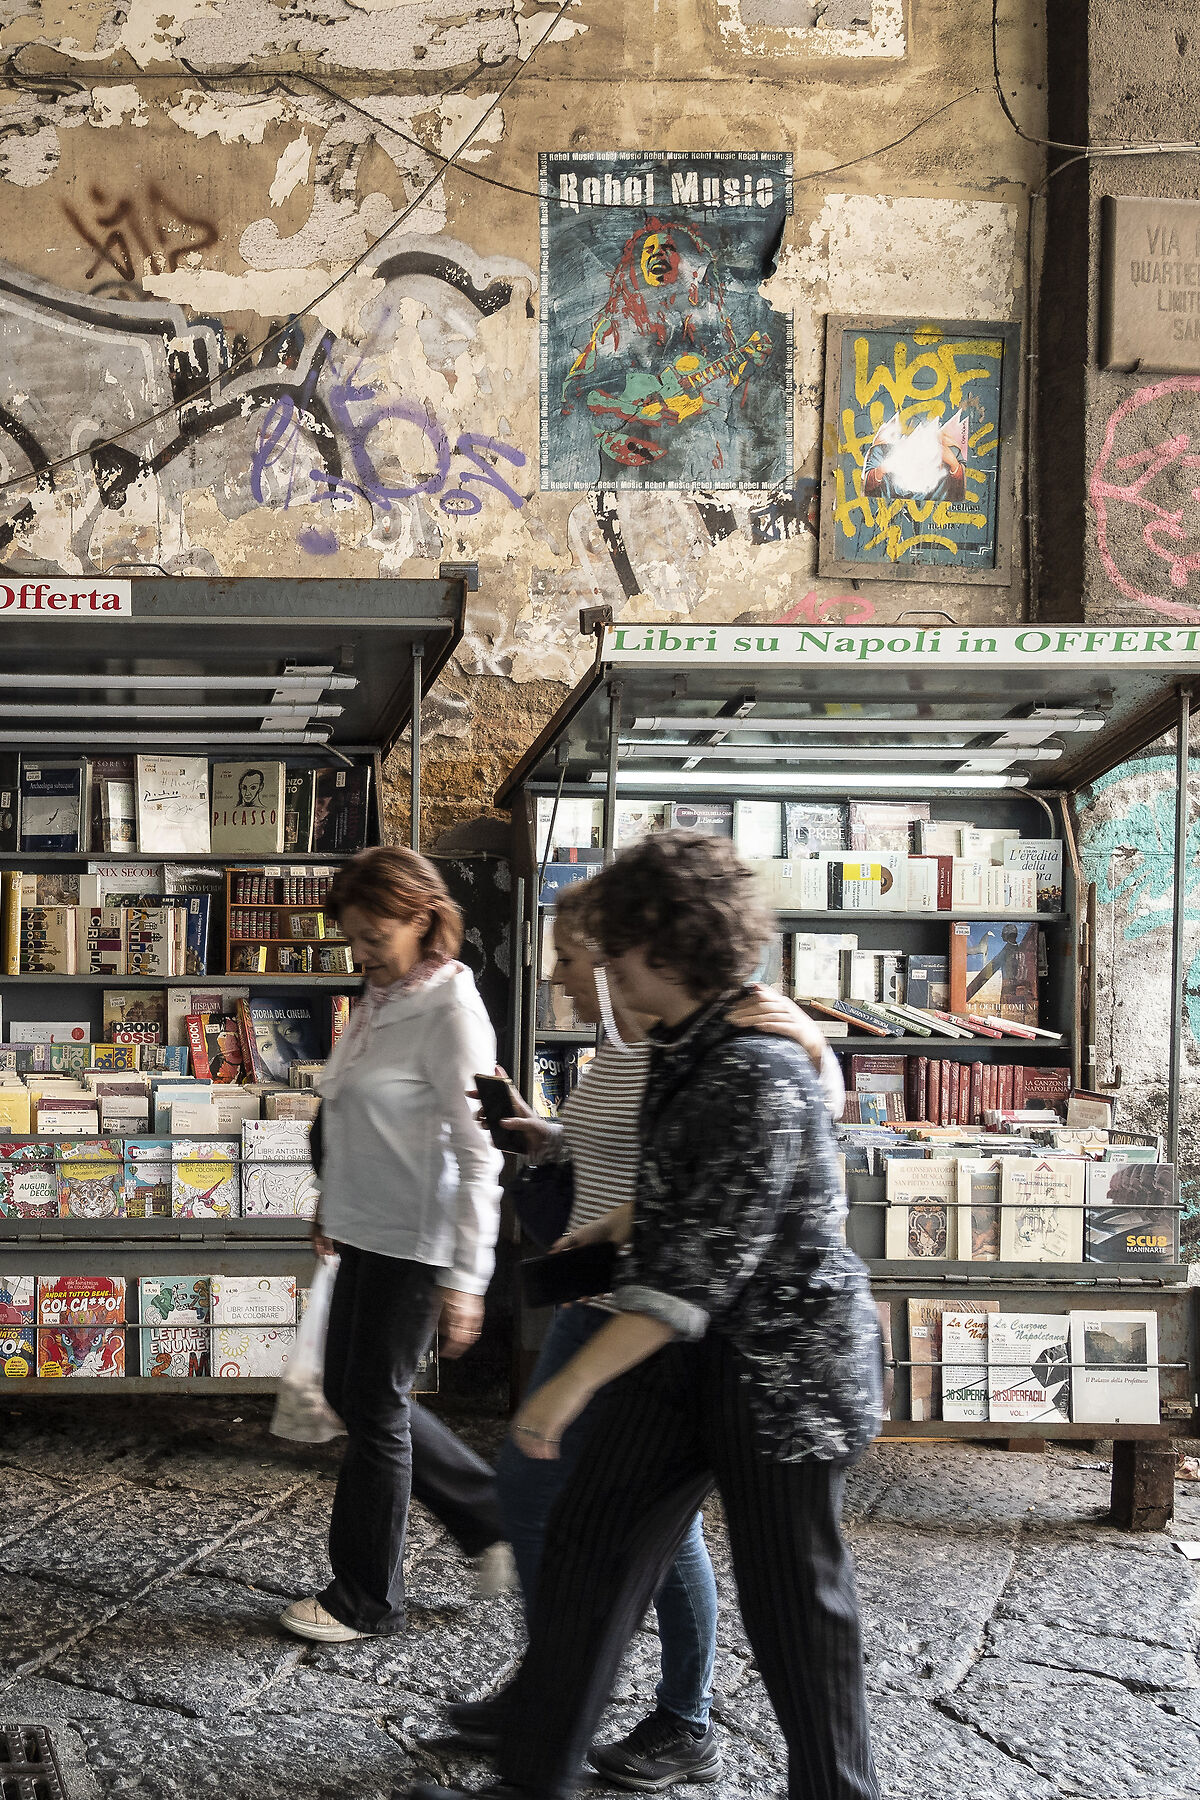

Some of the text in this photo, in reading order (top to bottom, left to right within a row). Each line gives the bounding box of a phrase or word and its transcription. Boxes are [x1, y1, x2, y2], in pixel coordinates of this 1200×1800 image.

[559, 171, 774, 213] Rebel Music
[1147, 225, 1180, 256] VIA
[611, 629, 718, 652] Libri
[734, 635, 780, 652] su
[800, 629, 943, 660] Napoli
[956, 629, 998, 653] in
[214, 810, 276, 826] PICASSO
[1010, 849, 1058, 862] L'eredità
[1022, 861, 1045, 871] della
[97, 868, 120, 877] XIX
[130, 909, 142, 975] ANTICA
[192, 1002, 220, 1010] HISPANIA
[252, 1009, 311, 1019] STORIA DEL CINEMA
[113, 1022, 159, 1033] paolo
[112, 1033, 160, 1044] rossi
[188, 1022, 202, 1052] IL ROCK
[41, 1299, 67, 1313] COL
[947, 1317, 961, 1327] La
[993, 1319, 1048, 1330] La Canzone
[1015, 1330, 1065, 1342] Napoletana
[150, 1343, 158, 1354] E
[1002, 1390, 1047, 1402] SUPERFACILI
